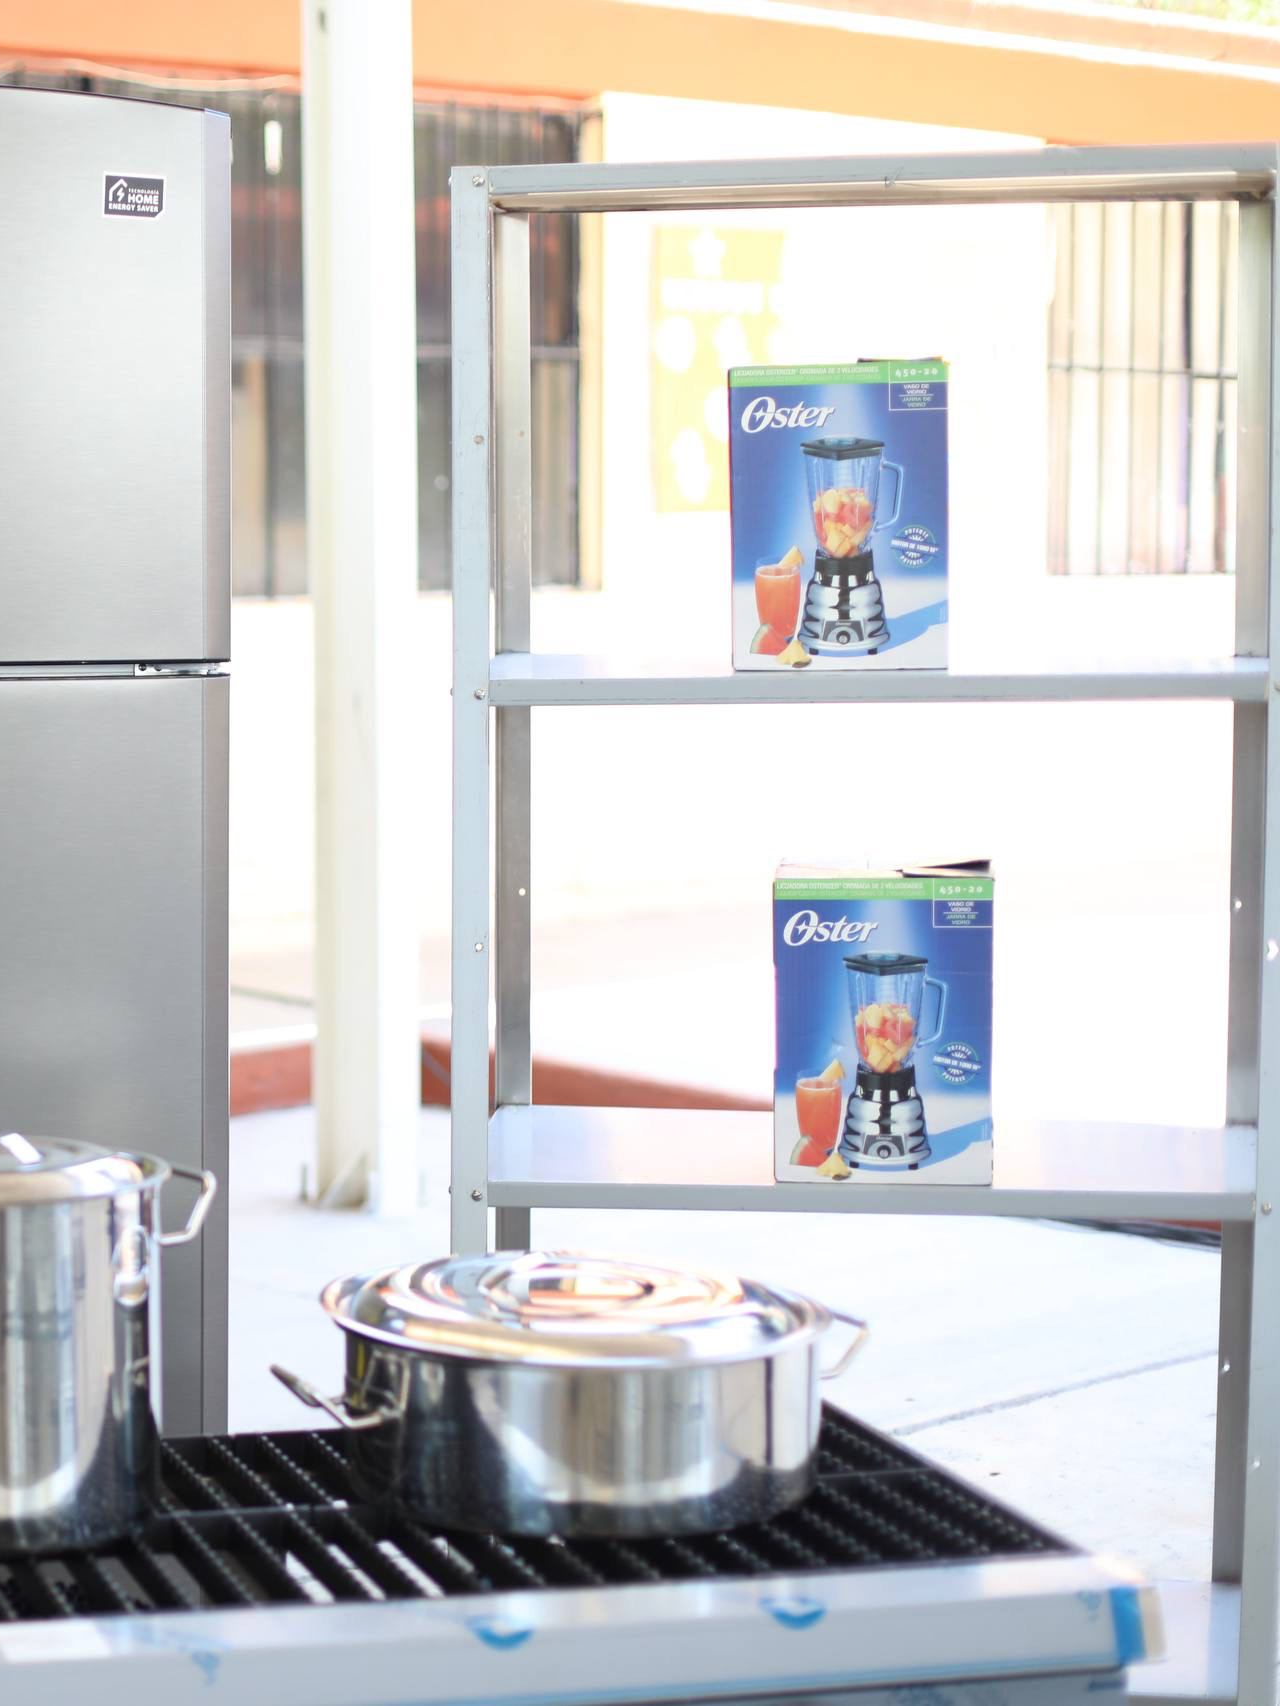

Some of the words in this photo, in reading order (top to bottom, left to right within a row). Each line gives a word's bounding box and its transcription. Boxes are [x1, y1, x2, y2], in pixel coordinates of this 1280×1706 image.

[108, 203, 135, 211] ENERGY
[137, 205, 159, 213] SAVER
[128, 193, 159, 205] HOME
[741, 396, 835, 433] Oster
[783, 909, 879, 946] Oster
